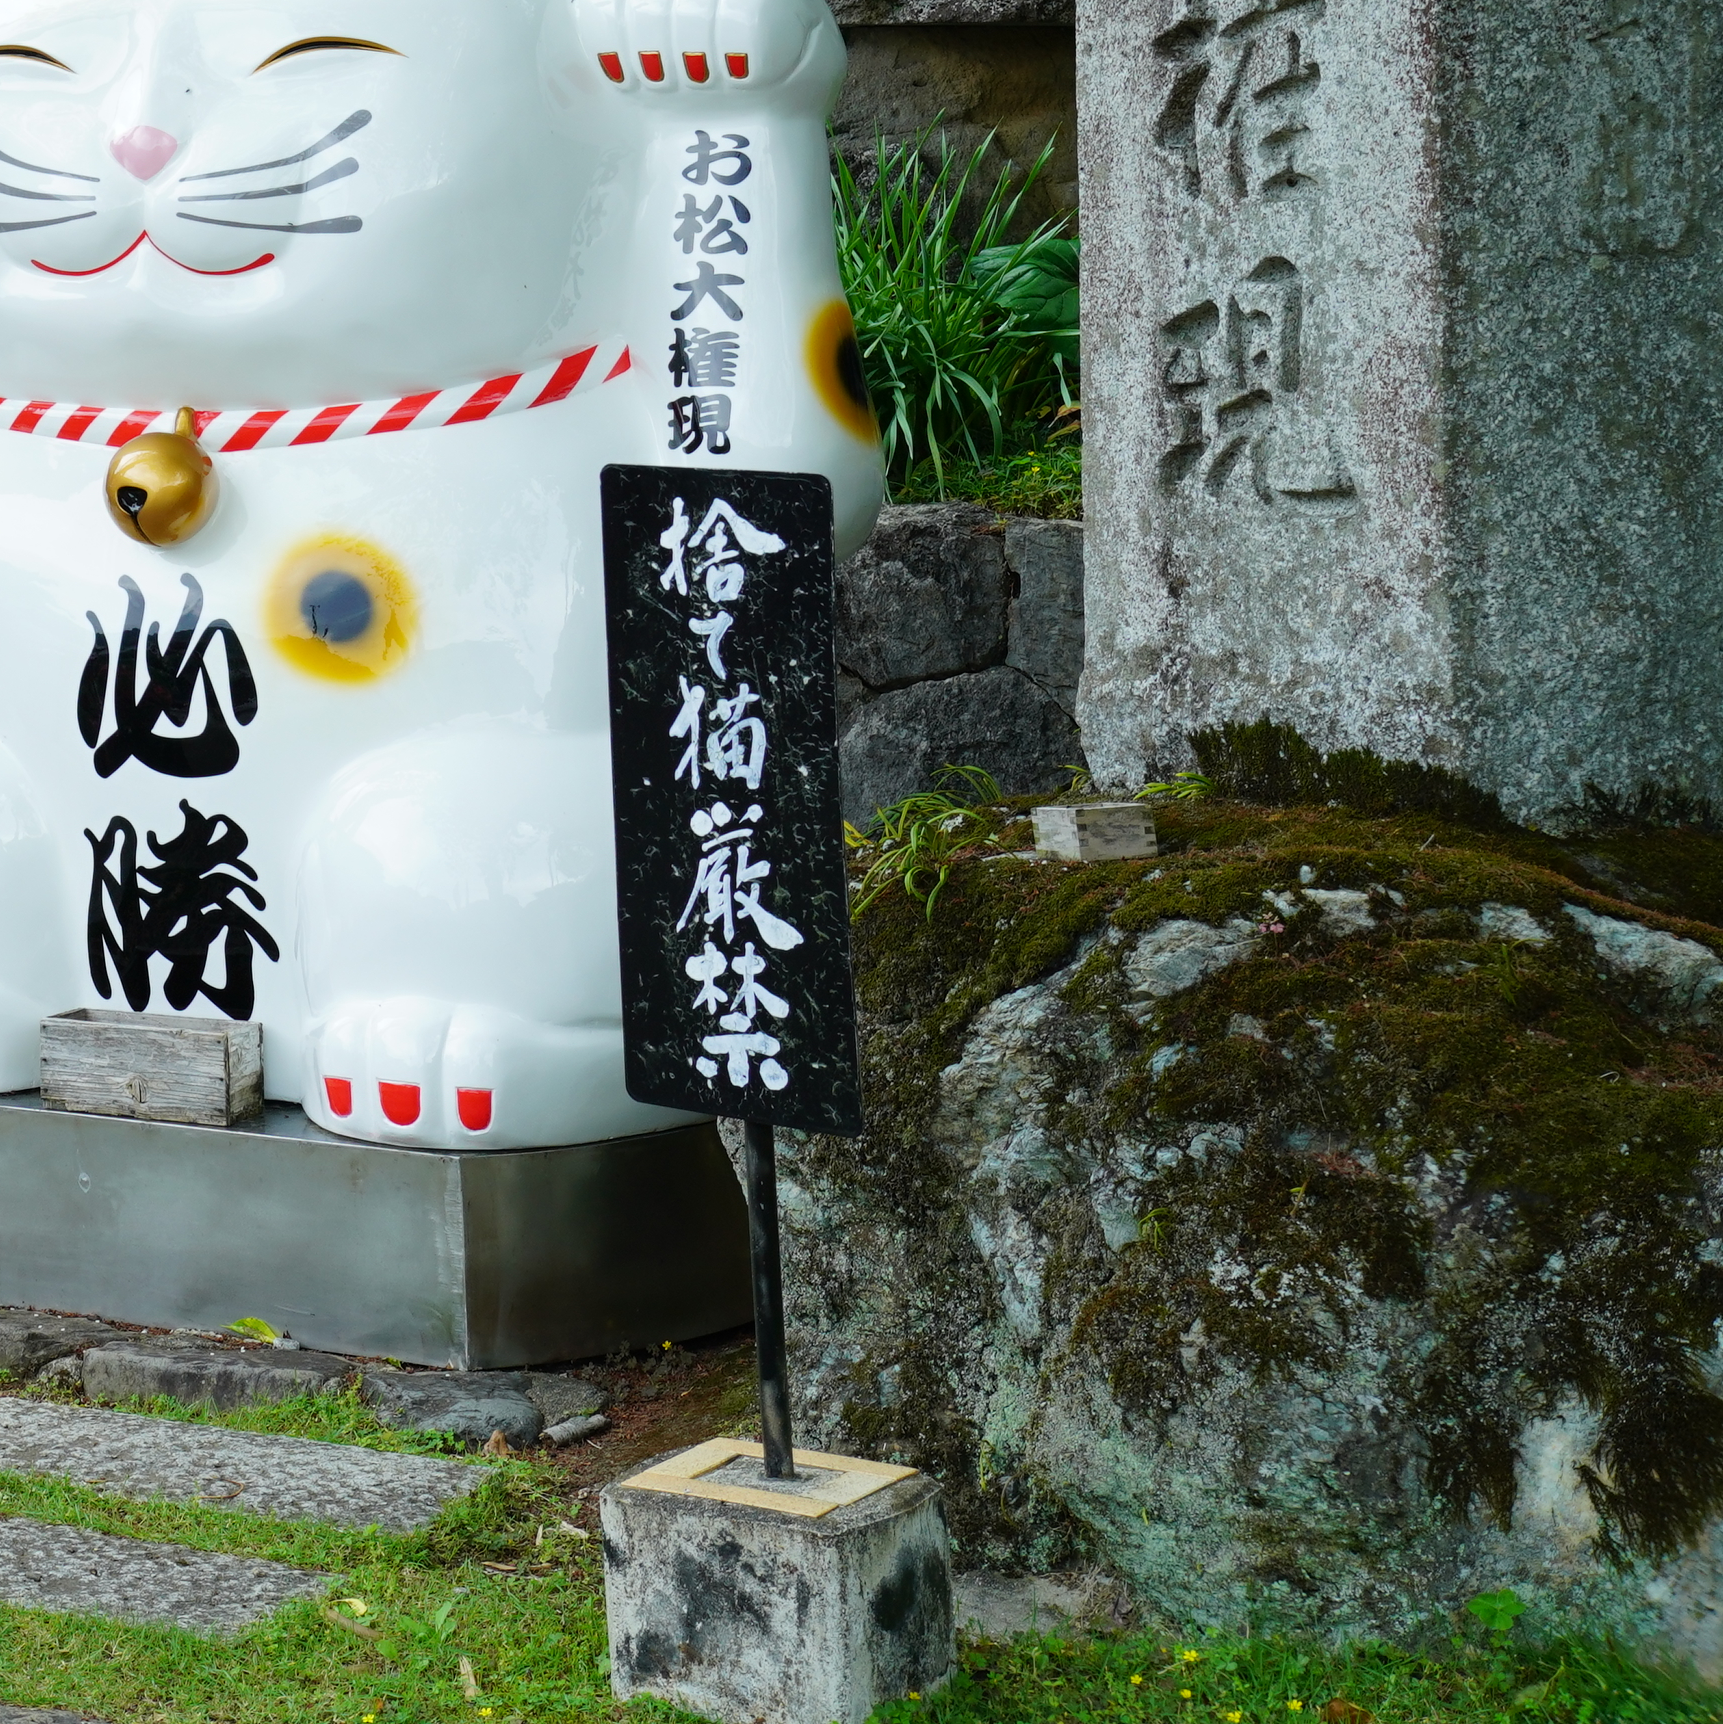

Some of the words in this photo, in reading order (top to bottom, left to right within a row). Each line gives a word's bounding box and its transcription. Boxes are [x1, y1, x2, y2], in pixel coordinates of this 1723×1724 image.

[667, 129, 753, 455] お松大権現
[76, 574, 281, 1022] 必勝
[659, 496, 805, 1092] 捨て猫厳禁
